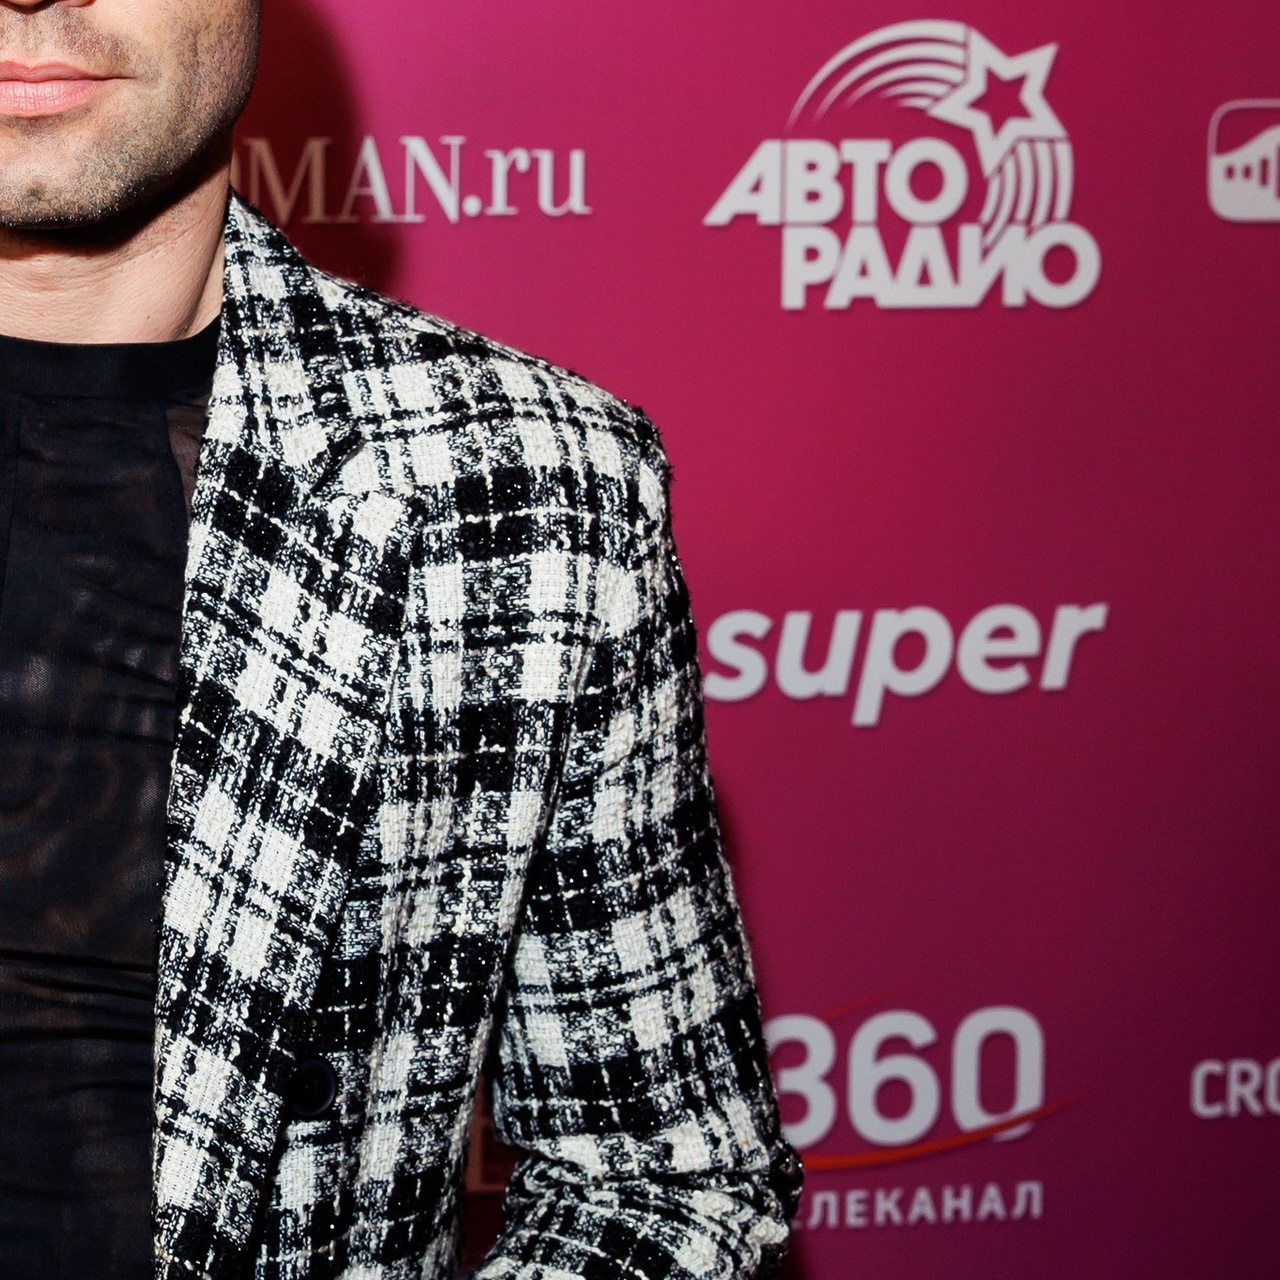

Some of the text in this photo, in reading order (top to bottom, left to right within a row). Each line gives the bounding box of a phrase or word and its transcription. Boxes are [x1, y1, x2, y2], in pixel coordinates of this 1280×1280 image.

[230, 135, 593, 225] MAN.ru
[704, 138, 969, 227] АВТО
[780, 222, 1102, 311] РАДИО
[703, 602, 1108, 727] super
[763, 1005, 1044, 1150] 360
[791, 1180, 1044, 1229] ЛЕКАНАЛ
